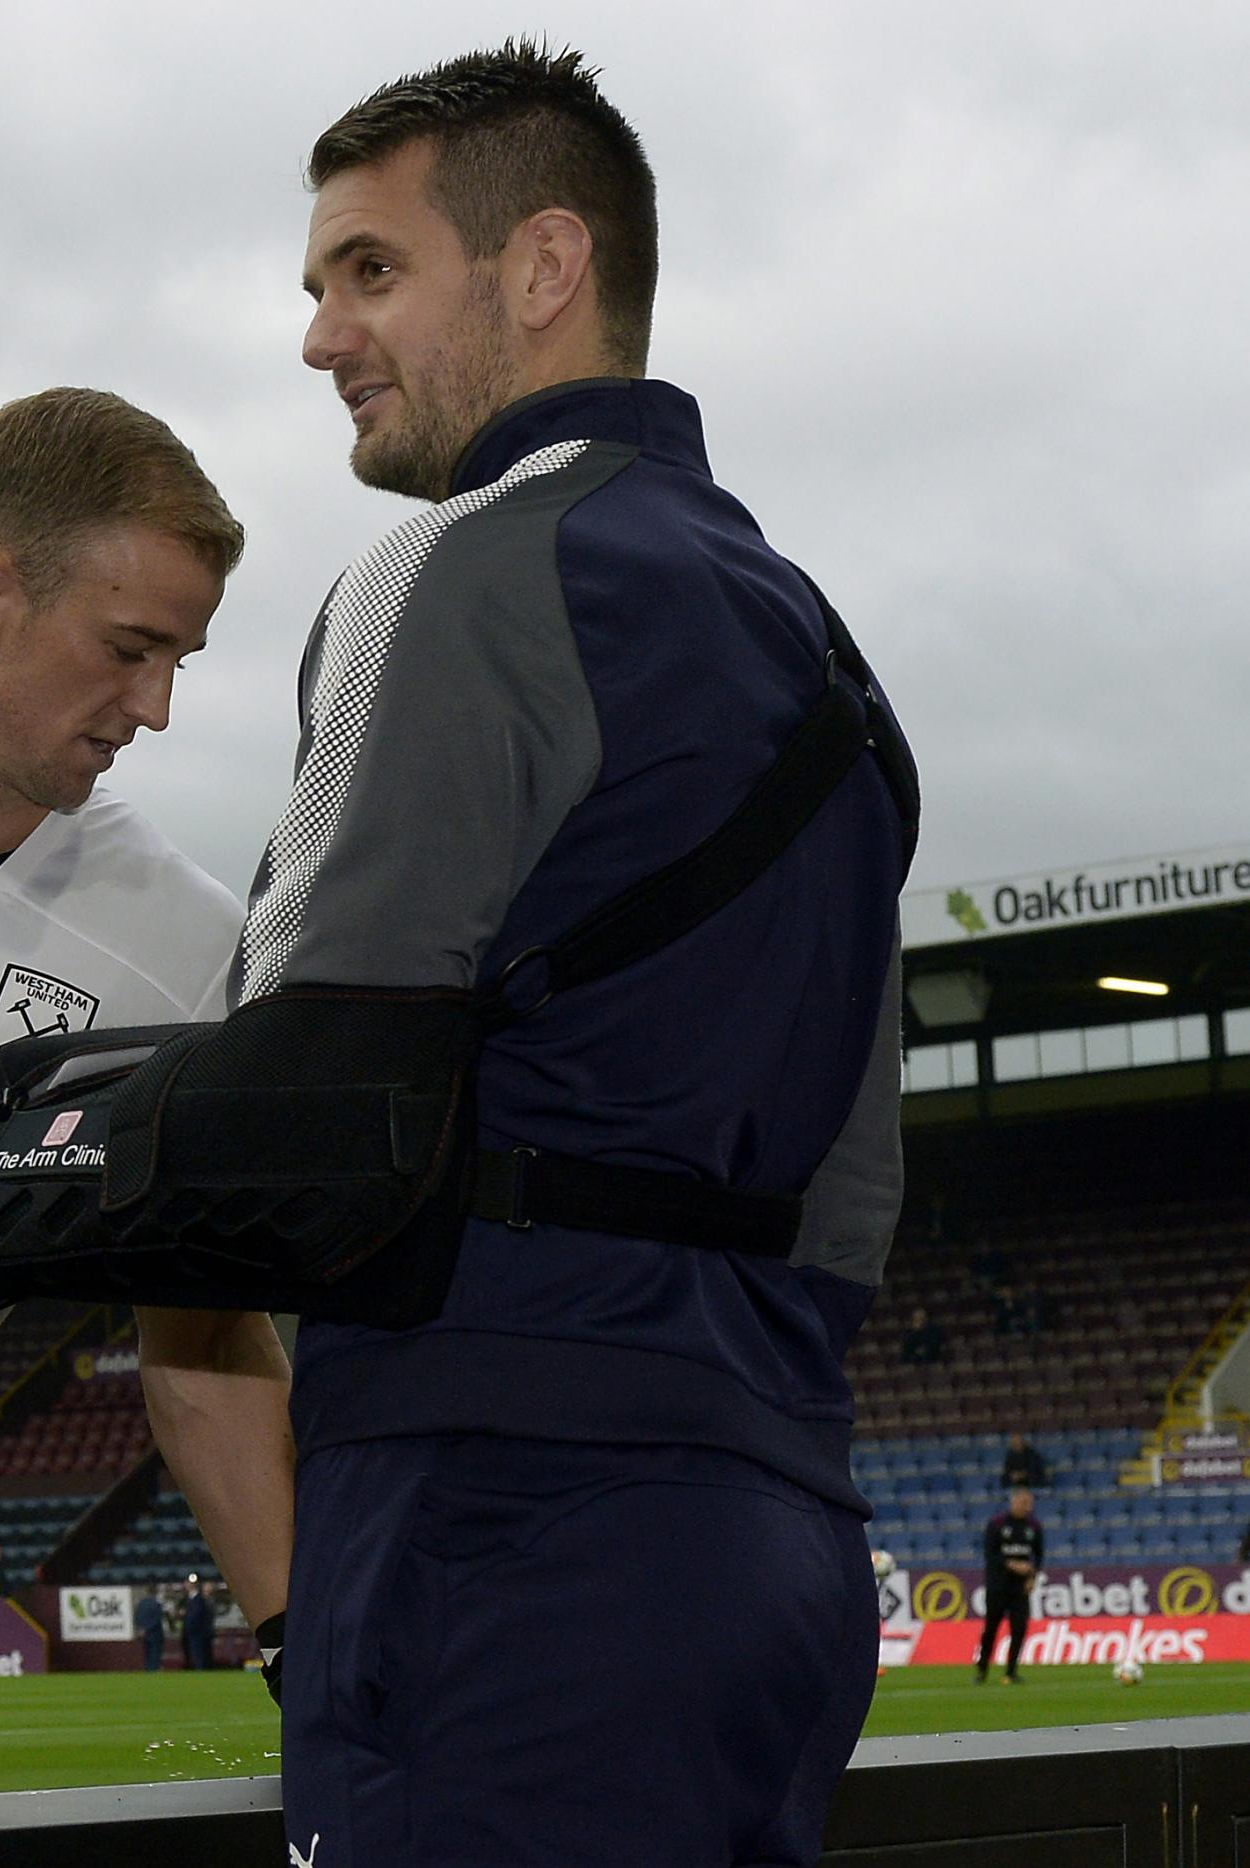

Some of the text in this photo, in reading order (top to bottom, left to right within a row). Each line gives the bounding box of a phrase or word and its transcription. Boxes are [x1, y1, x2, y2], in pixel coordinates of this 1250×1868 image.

[14, 971, 88, 1011] WEST HAM
[26, 987, 70, 1011] UNITED
[19, 1148, 58, 1168] Arm
[87, 1594, 123, 1617] Oak
[971, 1571, 1149, 1619] fabet
[973, 1617, 1208, 1665] dbrokes
